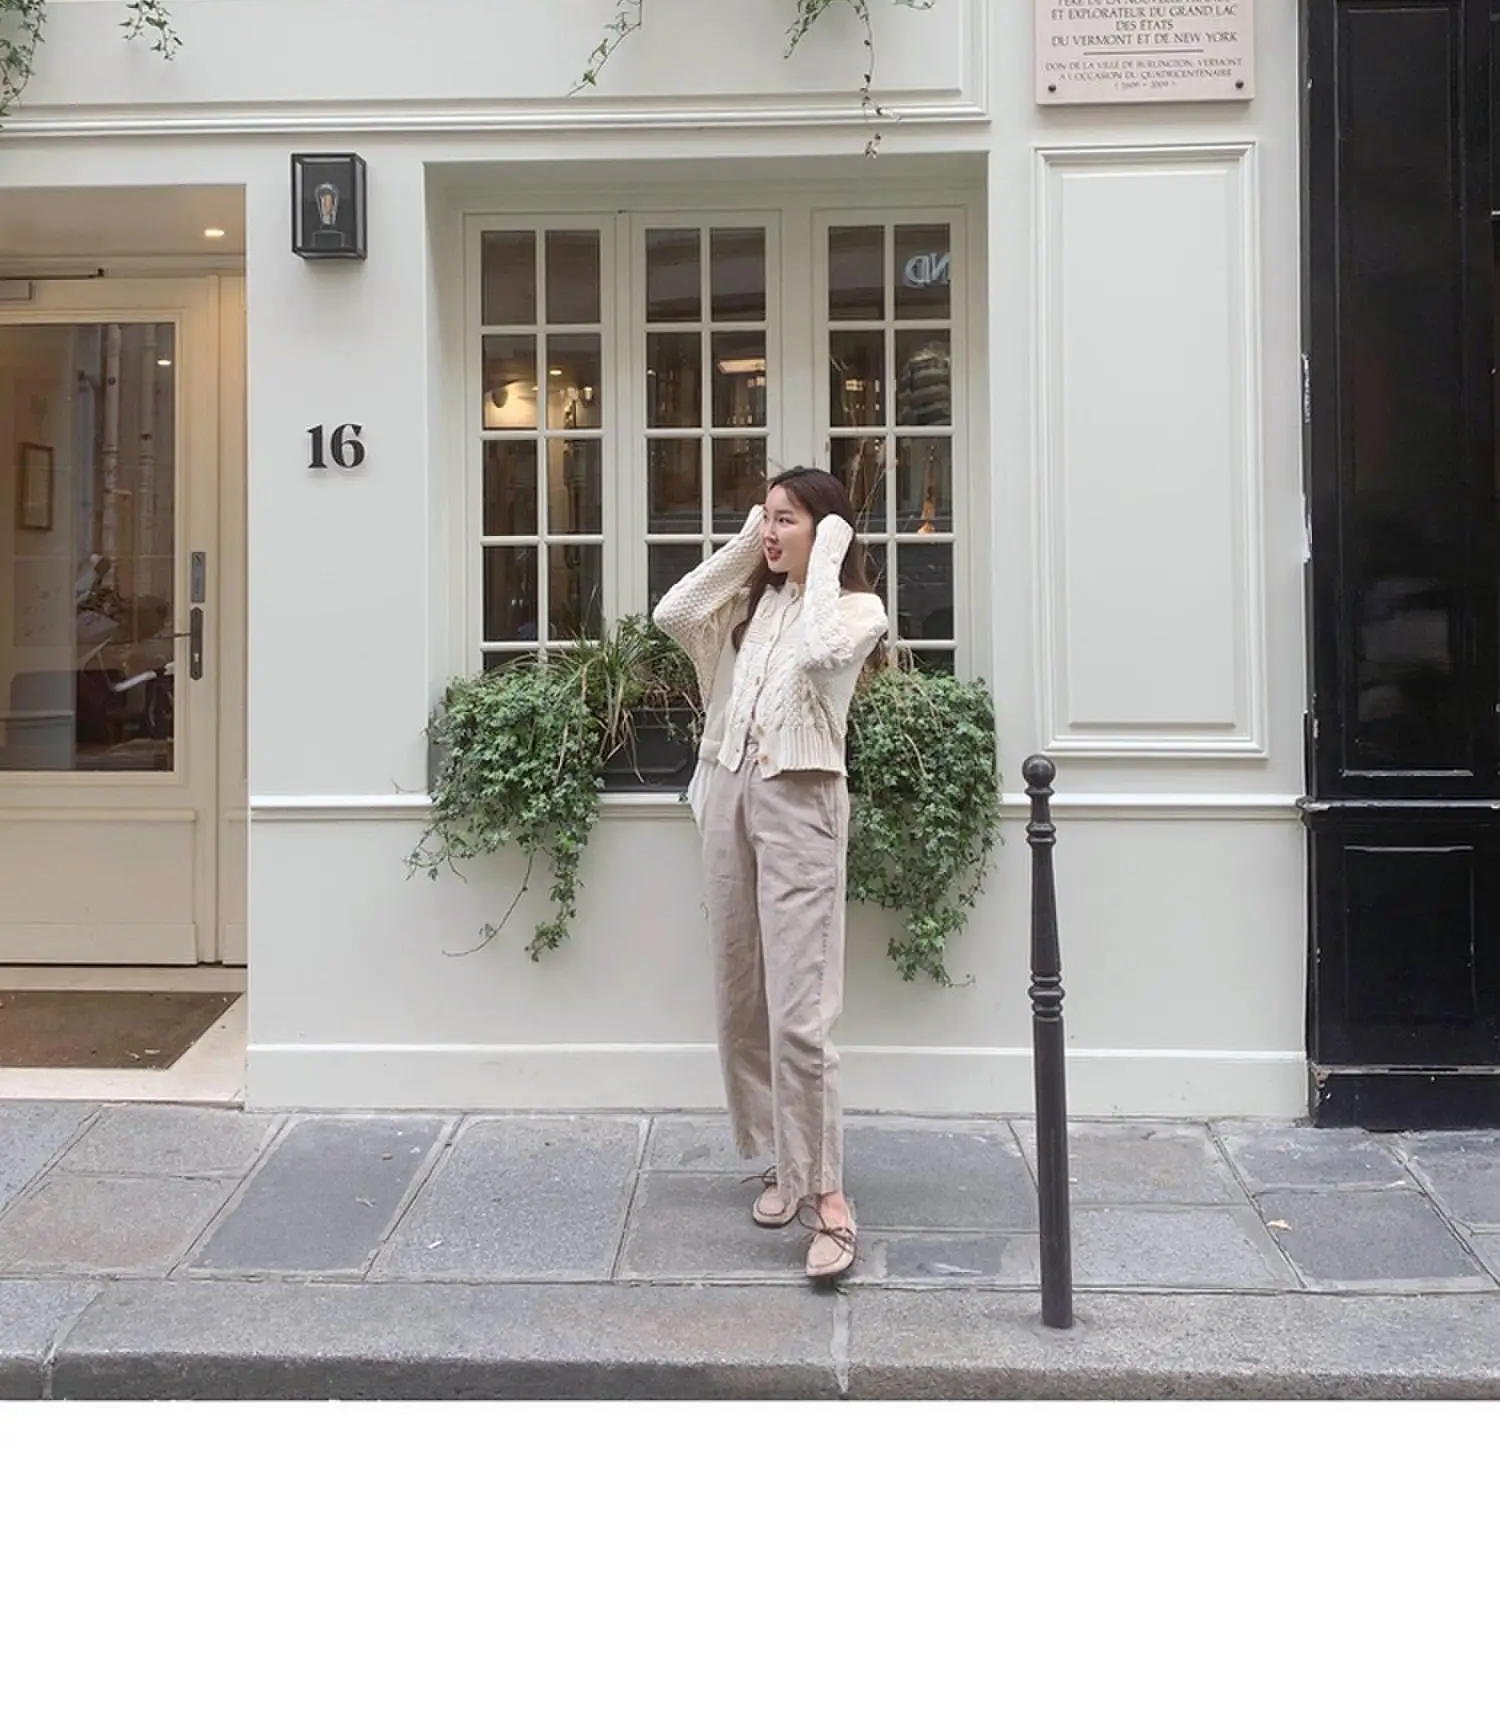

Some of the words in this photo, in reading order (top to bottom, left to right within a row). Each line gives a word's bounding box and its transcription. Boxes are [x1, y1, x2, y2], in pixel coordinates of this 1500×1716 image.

[1116, 21, 1137, 32] DES
[1051, 36, 1069, 47] DU
[1072, 35, 1133, 46] VERMONT
[1137, 34, 1150, 44] ET
[1154, 32, 1168, 44] DE
[1173, 32, 1201, 42] NEW
[1205, 31, 1237, 42] YORK
[307, 423, 365, 468] 16
